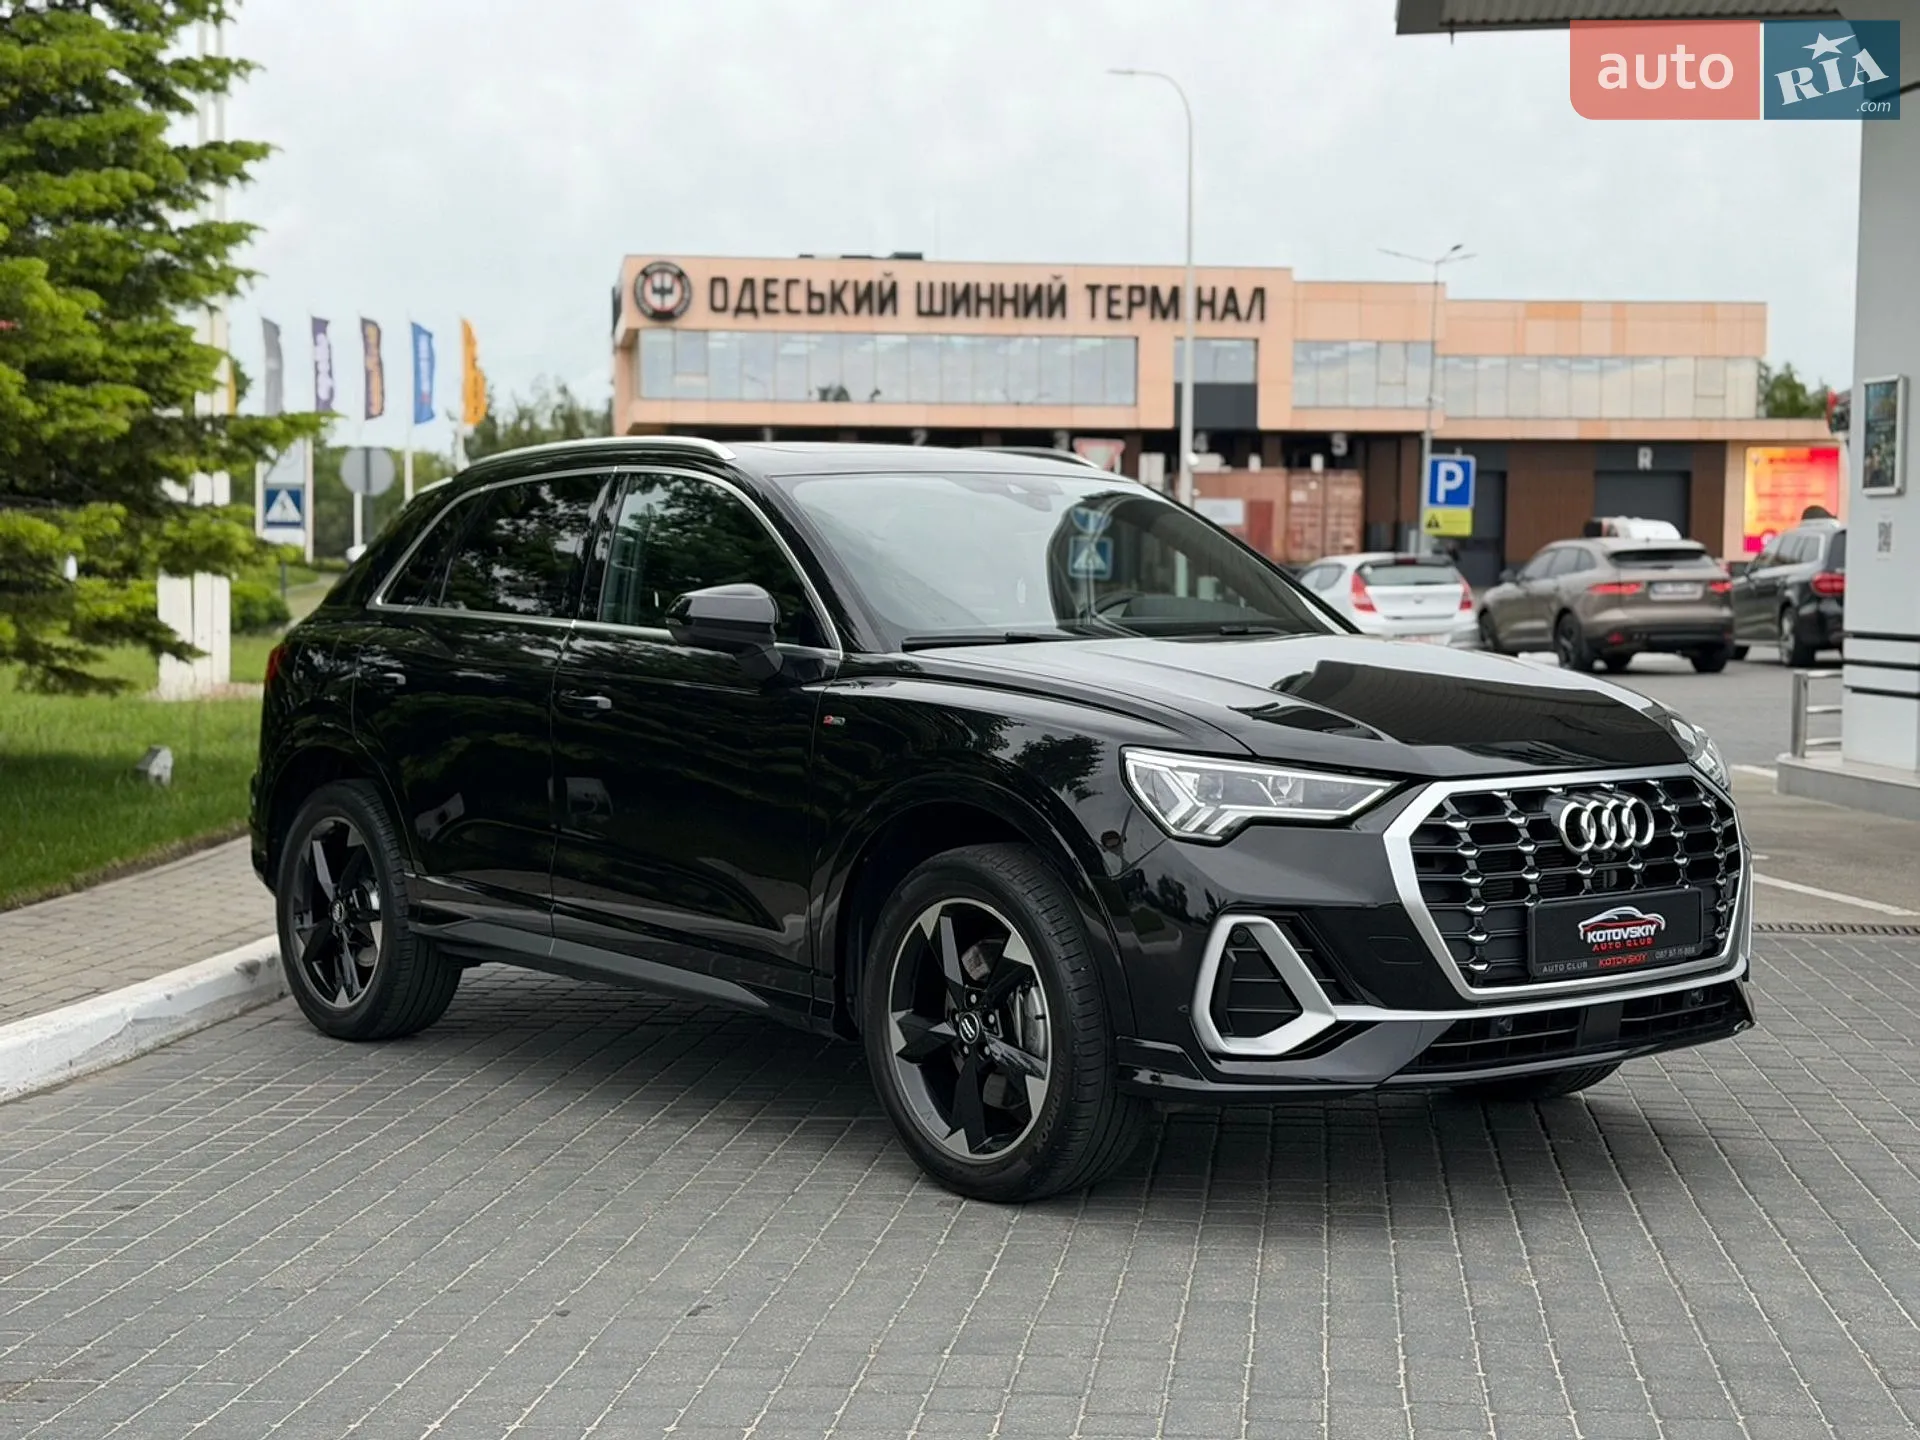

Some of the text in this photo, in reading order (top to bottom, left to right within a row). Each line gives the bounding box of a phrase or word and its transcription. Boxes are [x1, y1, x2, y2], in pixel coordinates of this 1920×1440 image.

[709, 273, 898, 318] ОДЕСЬКИЙ
[916, 275, 1068, 320] ШИННИЙ
[1085, 284, 1266, 322] ТЕРМНАЛ
[1637, 446, 1653, 472] R
[1436, 460, 1464, 504] P
[1587, 923, 1657, 944] KOTOVSKIY
[1592, 937, 1653, 952] AUTO CLUB
[1542, 963, 1564, 974] AUTO
[1567, 961, 1588, 971] CLUB
